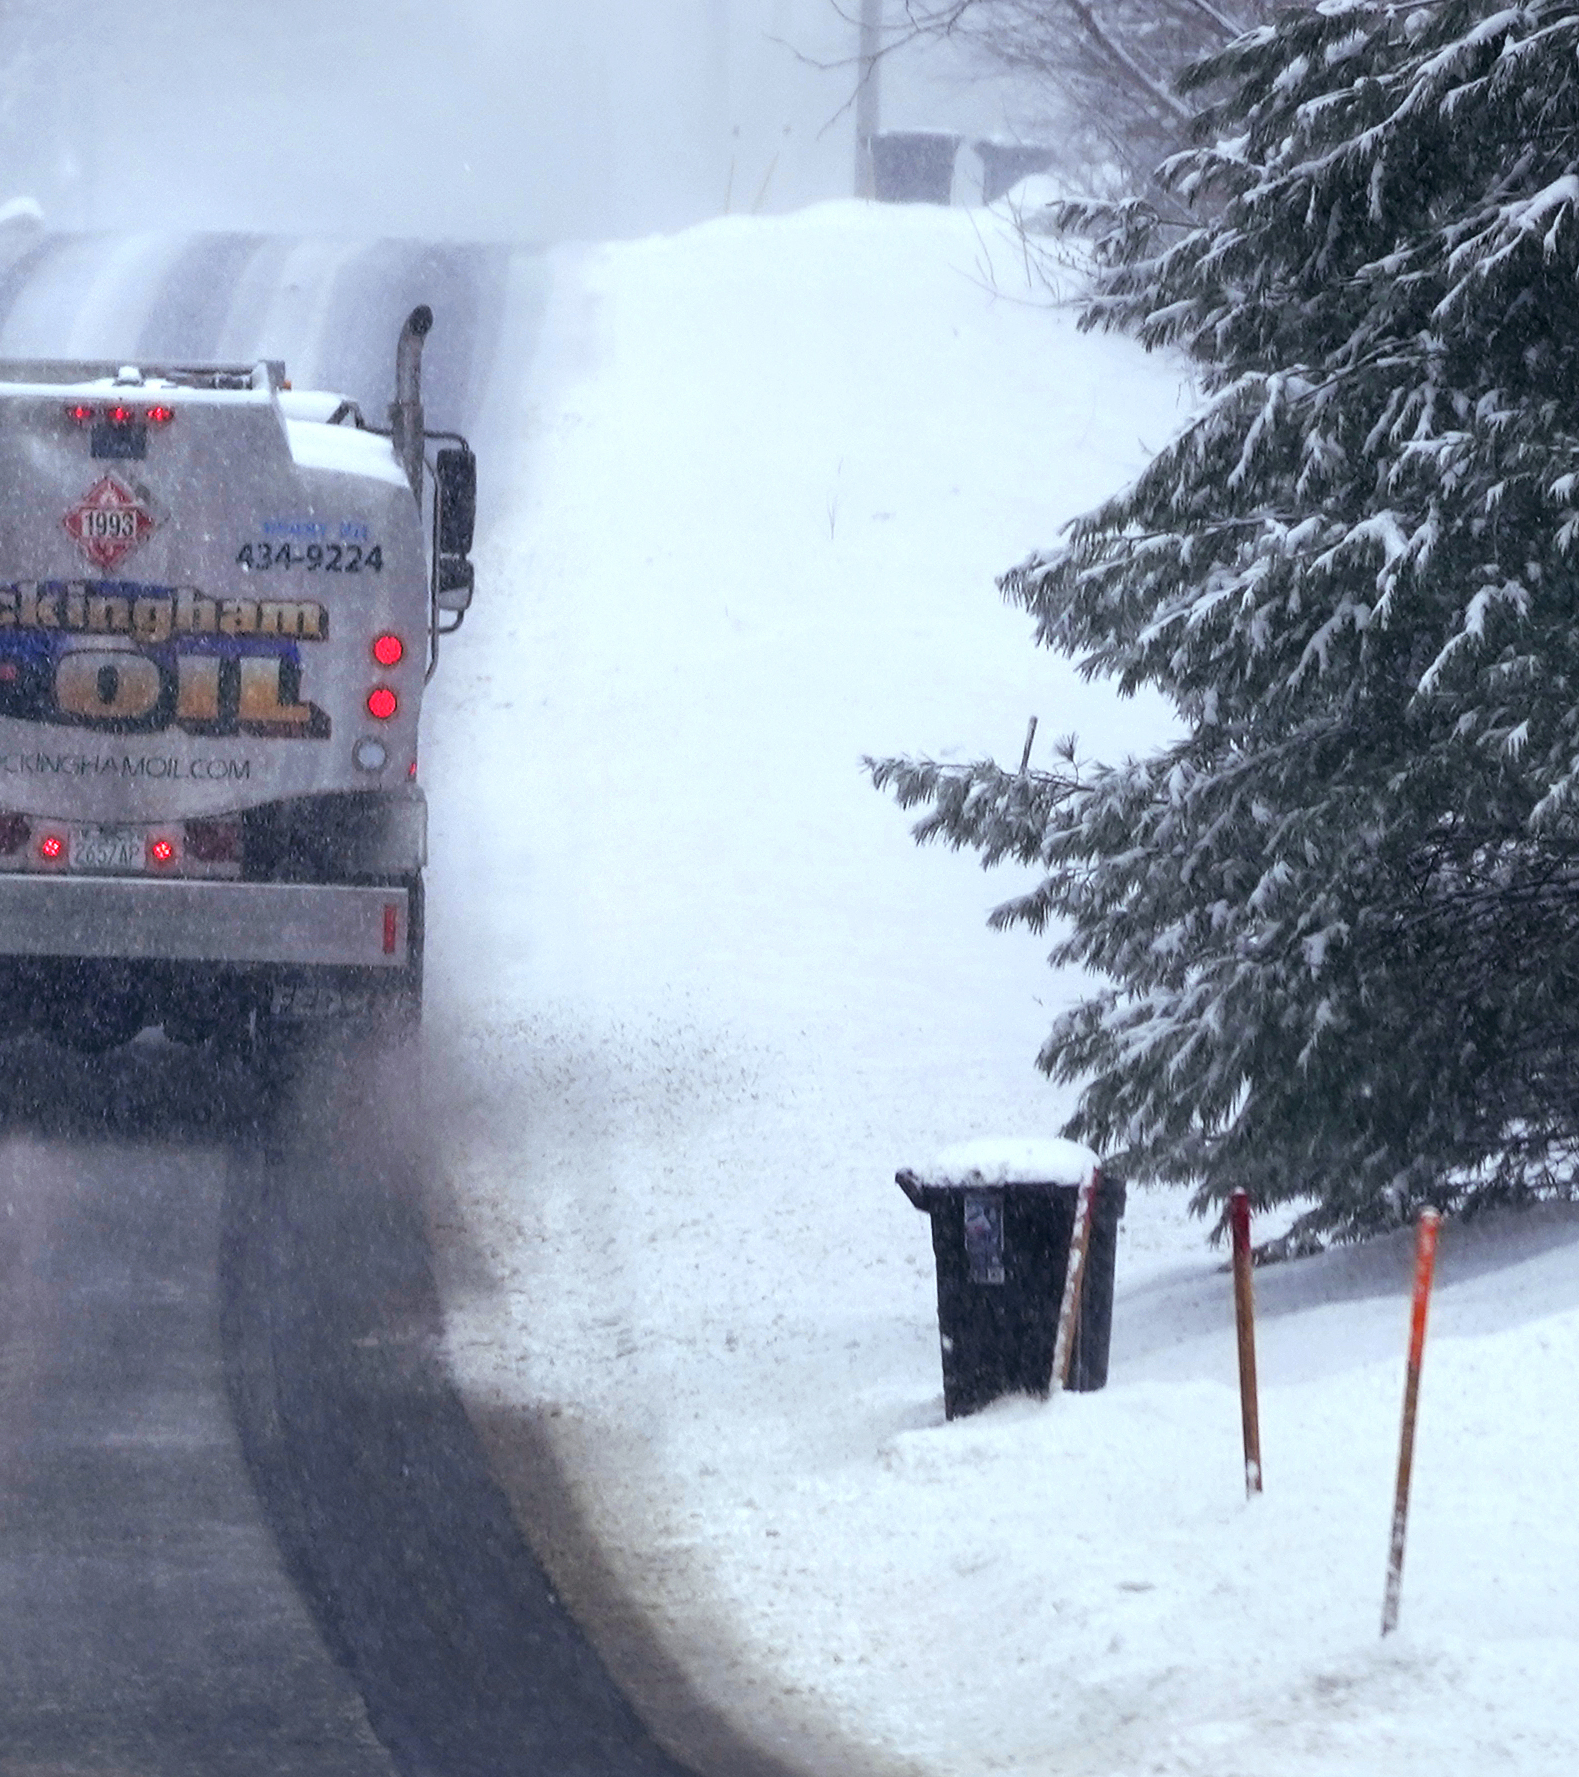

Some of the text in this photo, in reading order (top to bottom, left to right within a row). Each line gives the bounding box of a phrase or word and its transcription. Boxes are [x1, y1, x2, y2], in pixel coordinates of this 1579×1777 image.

[86, 511, 134, 536] 1993
[236, 543, 383, 573] 434-9224
[55, 647, 331, 738] OIL
